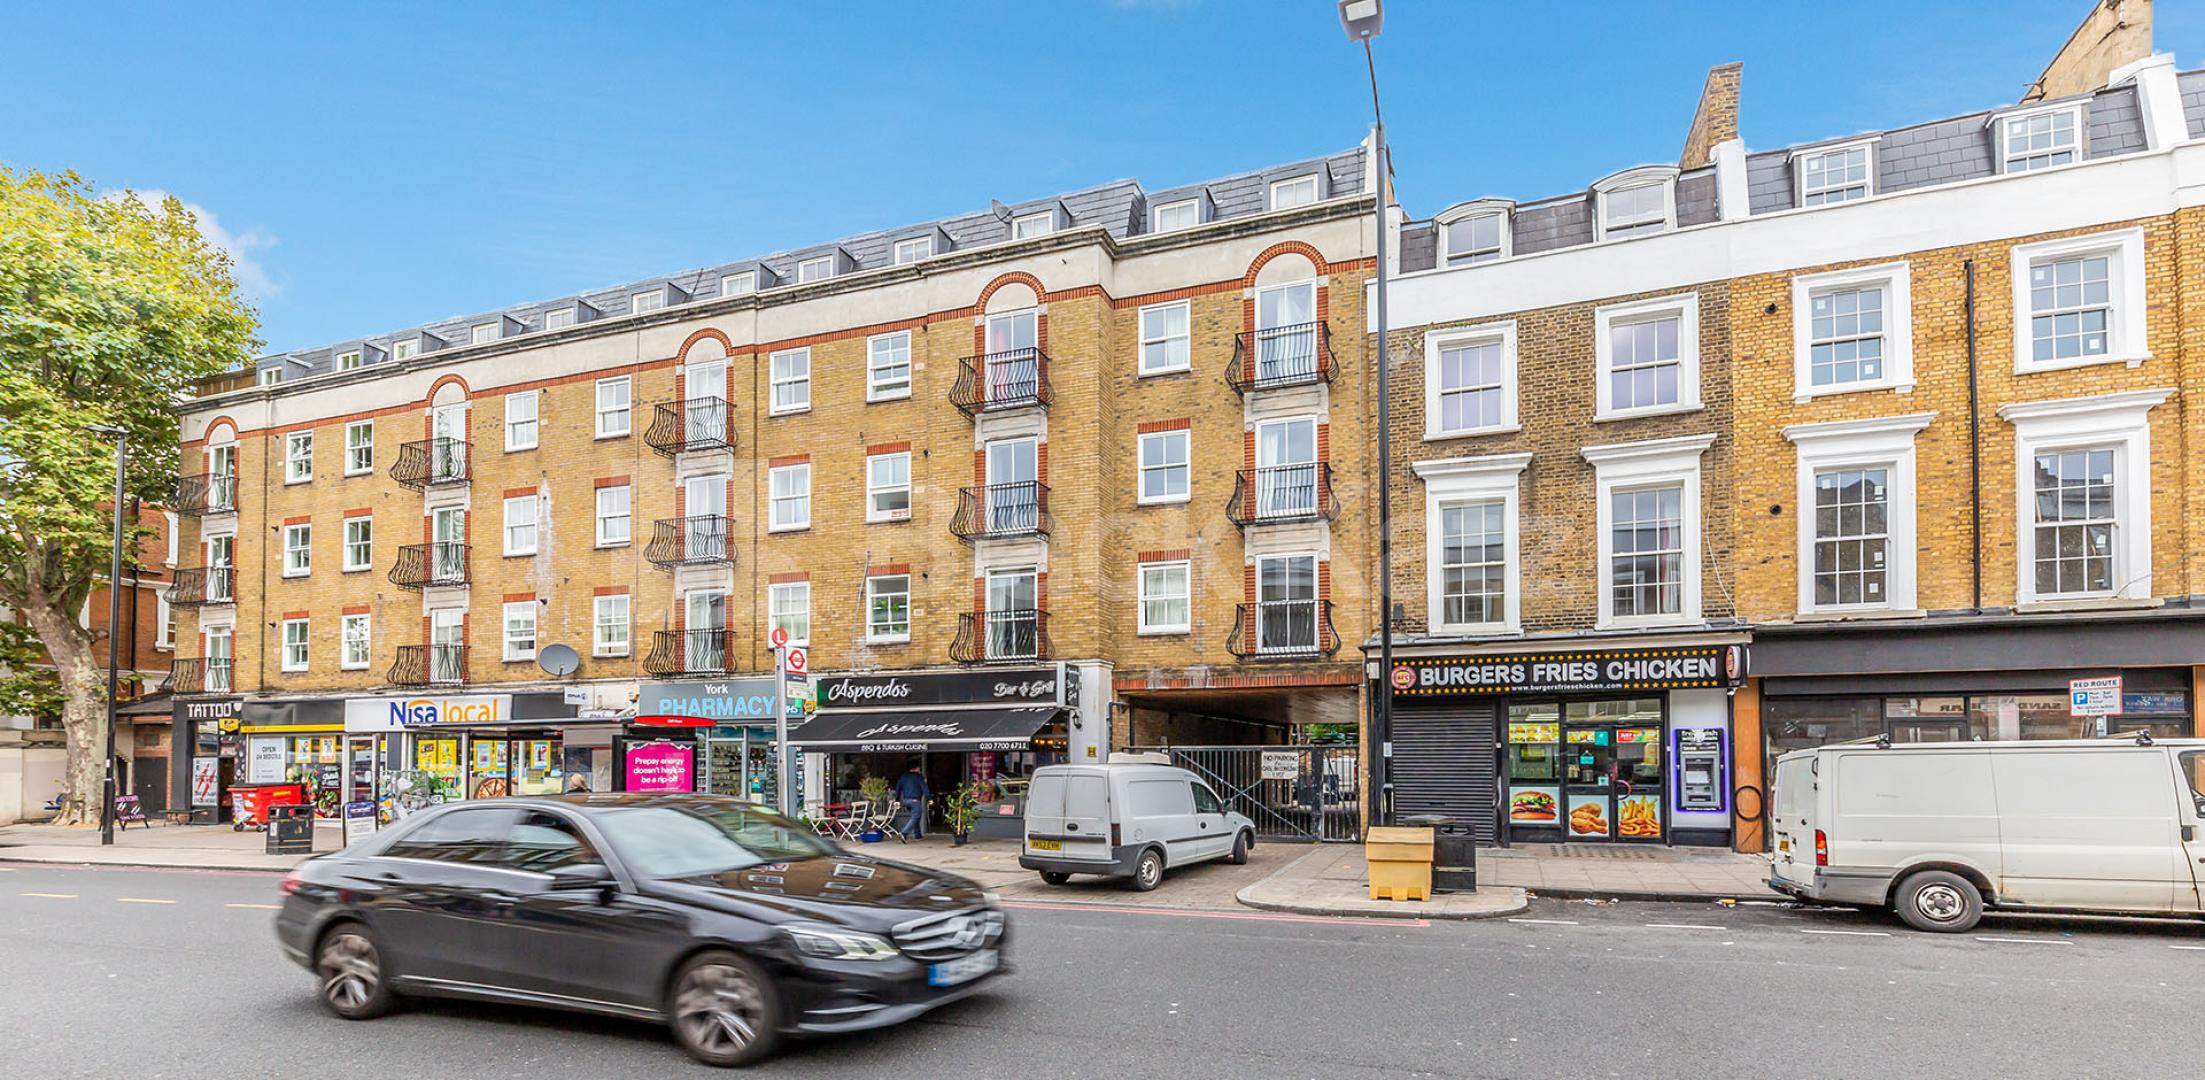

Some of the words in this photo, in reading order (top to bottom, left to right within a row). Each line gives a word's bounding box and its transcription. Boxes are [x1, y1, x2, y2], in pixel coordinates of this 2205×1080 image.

[1419, 664, 1526, 686] BURGERS
[1532, 662, 1598, 683] FRIES
[1606, 658, 1717, 680] CHICKEN
[704, 683, 729, 695] York
[828, 678, 910, 703] Aspendos
[993, 682, 1019, 697] Bar
[1029, 680, 1055, 697] Grill
[1511, 683, 1622, 691] www.burgersfrieschicken.com
[187, 703, 232, 718] TATTOO
[389, 700, 438, 726] Nisa
[443, 698, 497, 722] local
[659, 696, 777, 717] PHARMACY
[856, 722, 965, 738] Aspendos
[861, 744, 875, 752] BBQ
[980, 742, 992, 750] 020
[993, 742, 1010, 750] 7700
[1011, 742, 1026, 750] 6711
[634, 757, 659, 766] Prepay
[660, 758, 684, 766] energy
[633, 766, 660, 774] doesn't
[657, 775, 678, 784] rip-off
